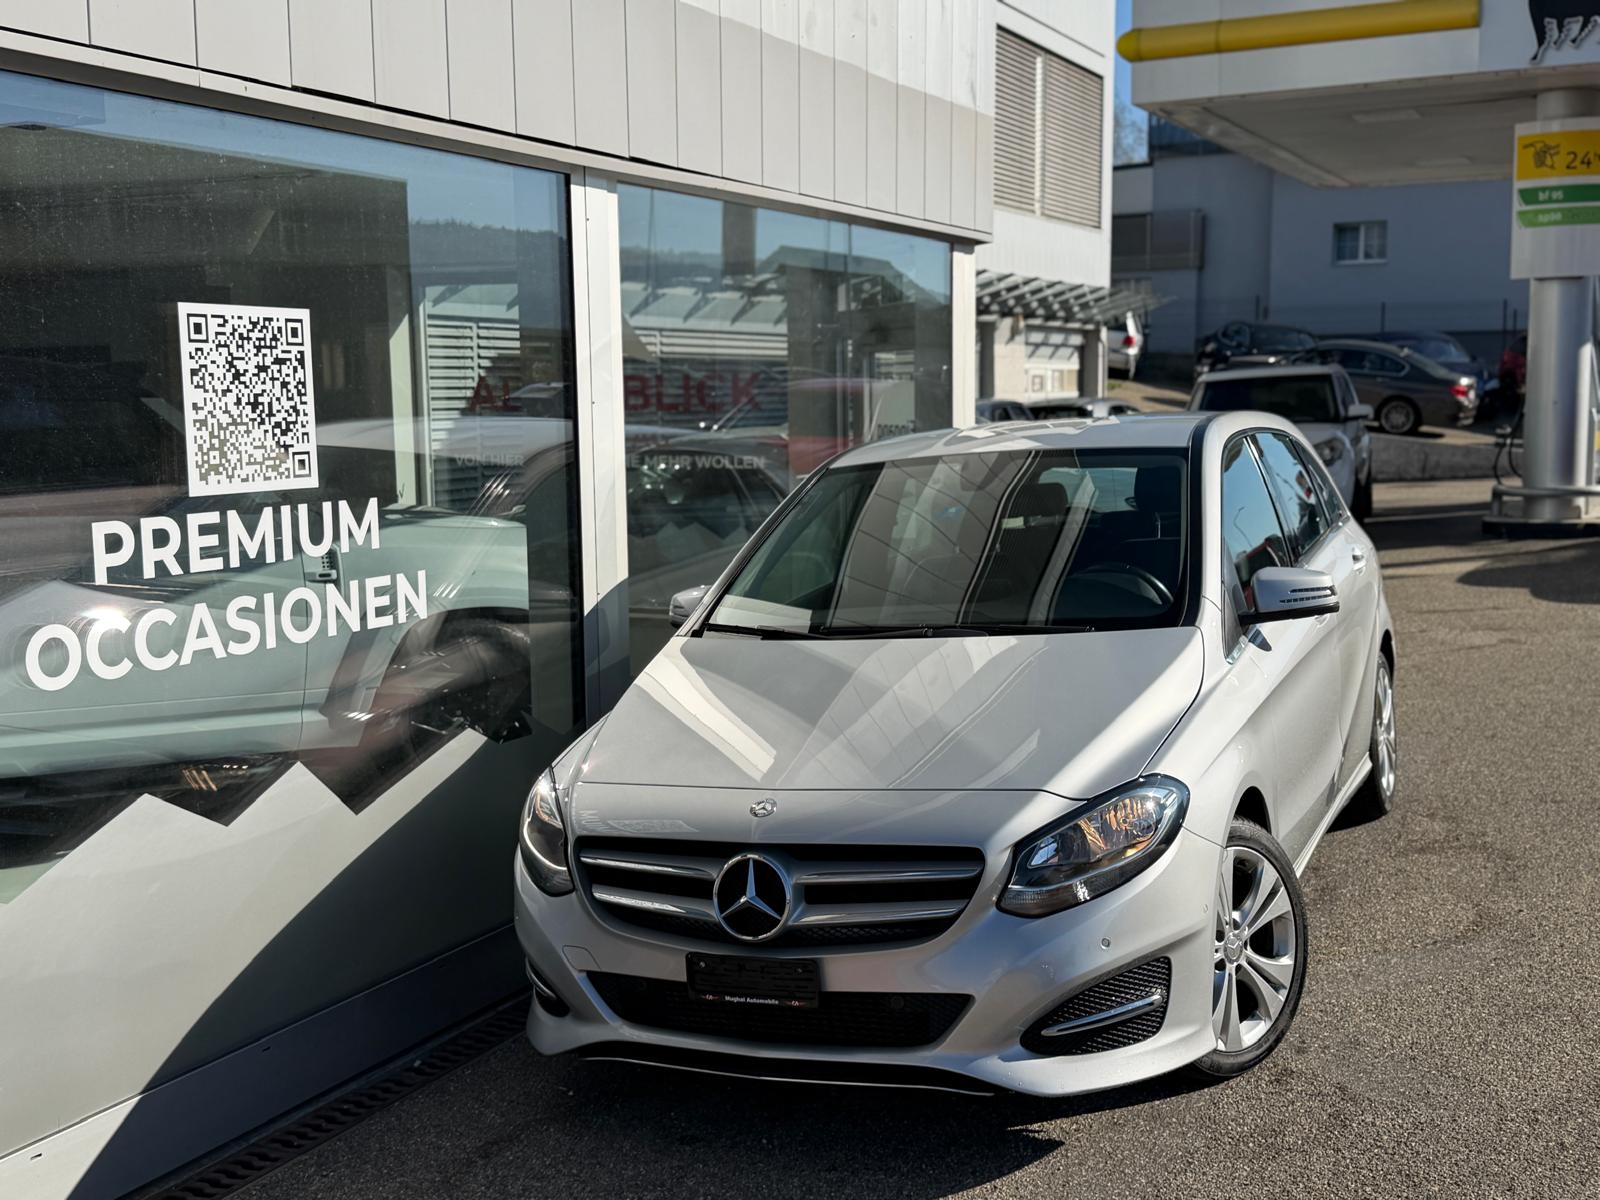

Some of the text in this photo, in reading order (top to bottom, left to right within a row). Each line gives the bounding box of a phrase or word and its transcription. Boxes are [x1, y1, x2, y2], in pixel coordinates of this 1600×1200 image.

[644, 455, 692, 469] MEHR
[694, 455, 765, 469] WOLLEN
[91, 497, 380, 585] PREMIUM
[25, 570, 428, 691] OCCASIONEN
